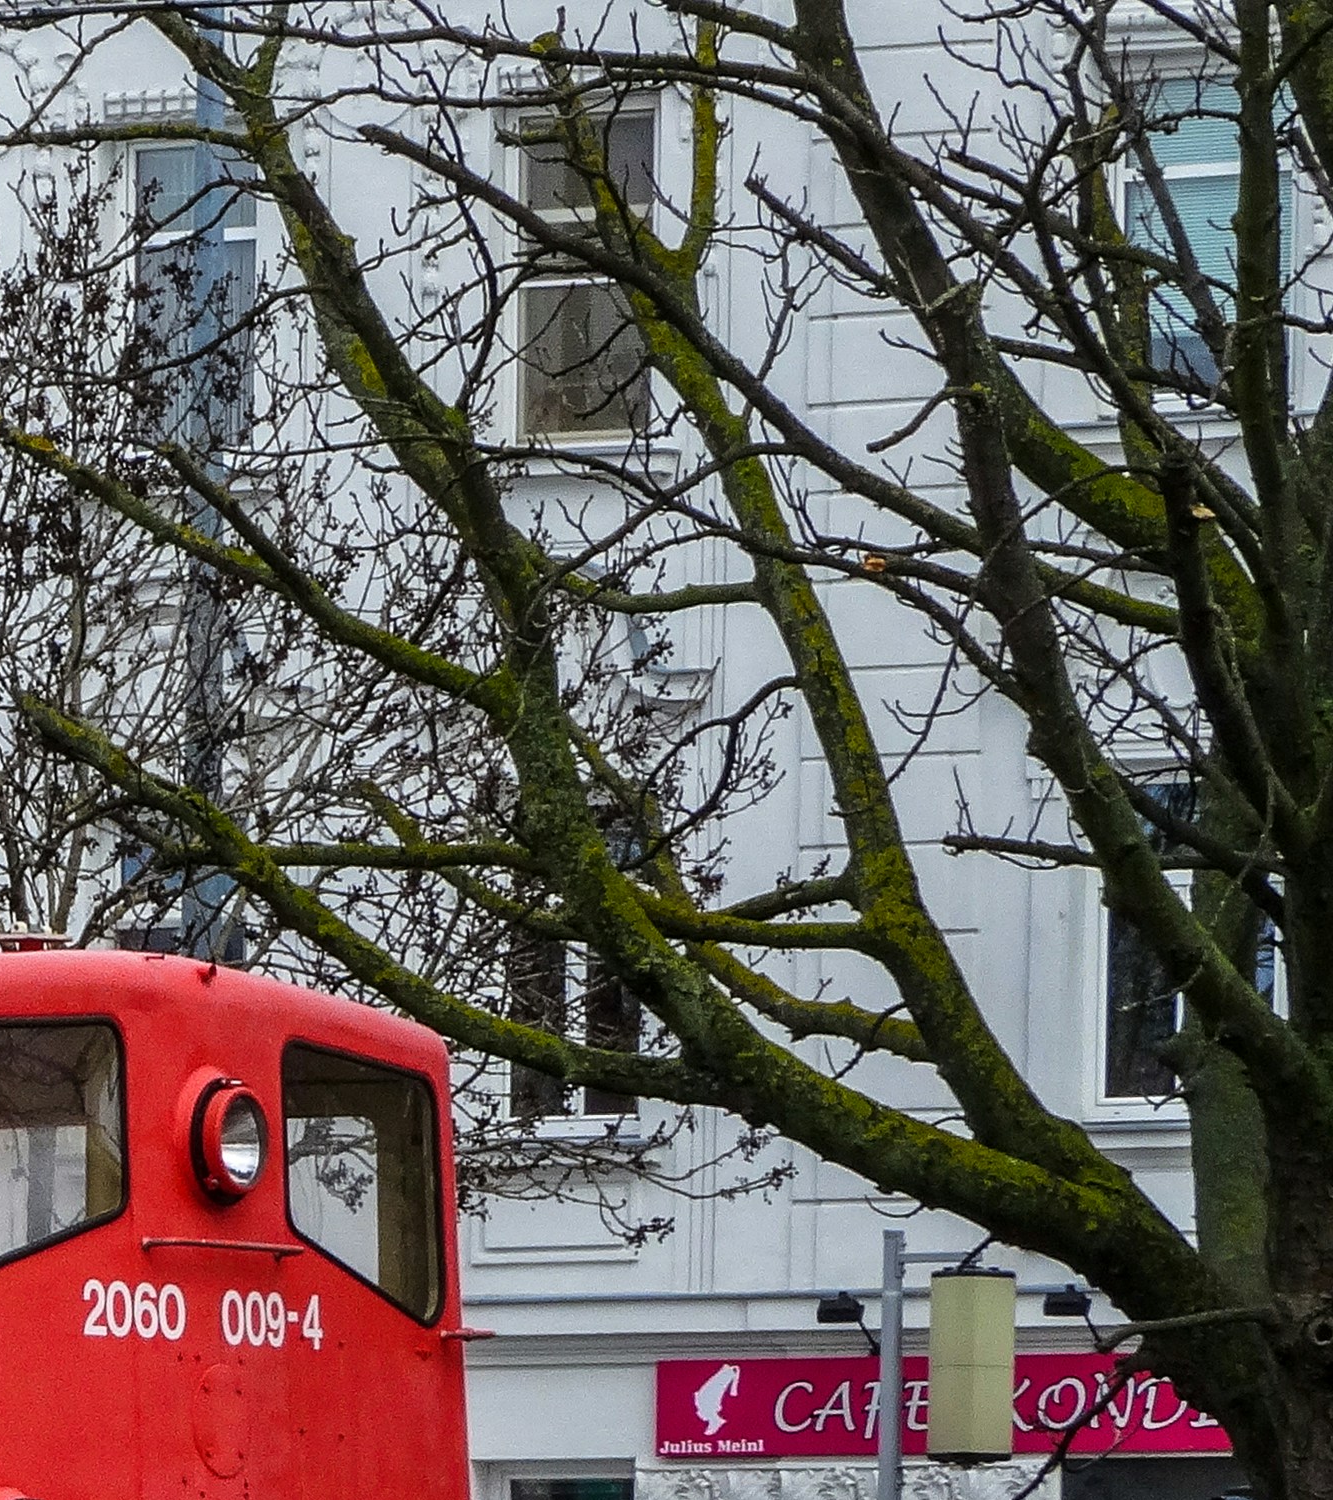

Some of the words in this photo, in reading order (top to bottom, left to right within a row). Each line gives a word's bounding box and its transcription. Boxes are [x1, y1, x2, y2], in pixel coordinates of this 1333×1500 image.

[82, 1278, 186, 1341] 2060
[220, 1289, 324, 1351] 009-4
[659, 1440, 712, 1454] Julius
[717, 1439, 764, 1453] Meinl
